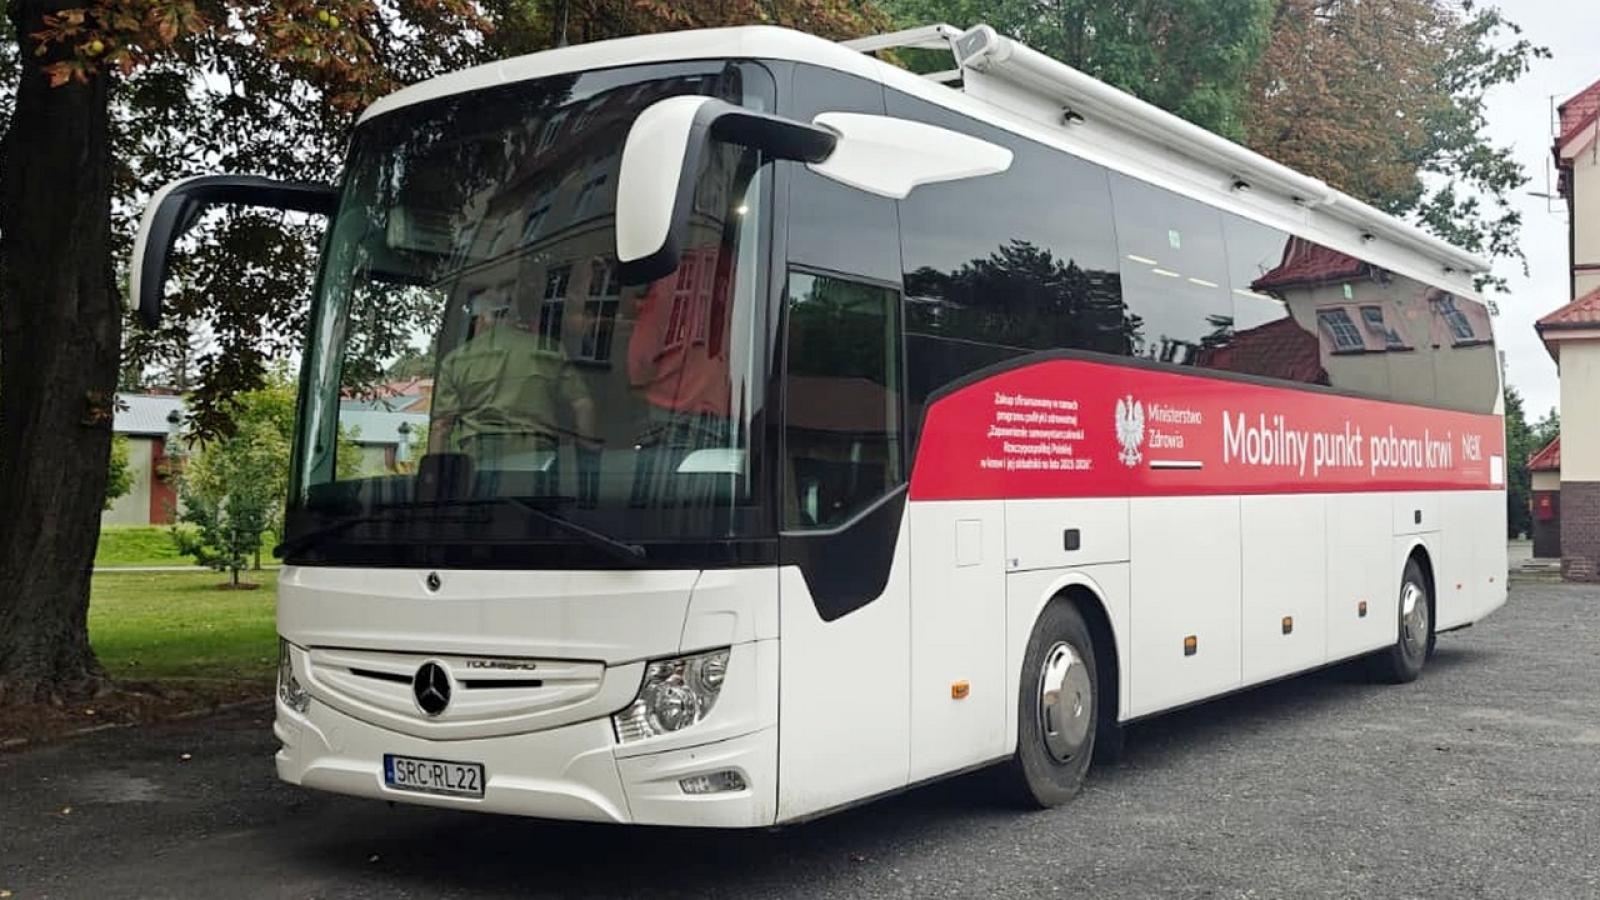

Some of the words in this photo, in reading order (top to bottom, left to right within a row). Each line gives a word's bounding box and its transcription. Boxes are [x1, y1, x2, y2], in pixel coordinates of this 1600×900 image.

[1148, 403, 1202, 424] Ministerstwo
[1148, 428, 1184, 449] Zdrowia
[1222, 409, 1309, 477] Mobilny
[1313, 420, 1364, 477] punkt
[1370, 424, 1422, 476] poboru
[1424, 428, 1453, 468] krwi
[396, 759, 428, 785] SRC
[432, 764, 479, 791] RL22
